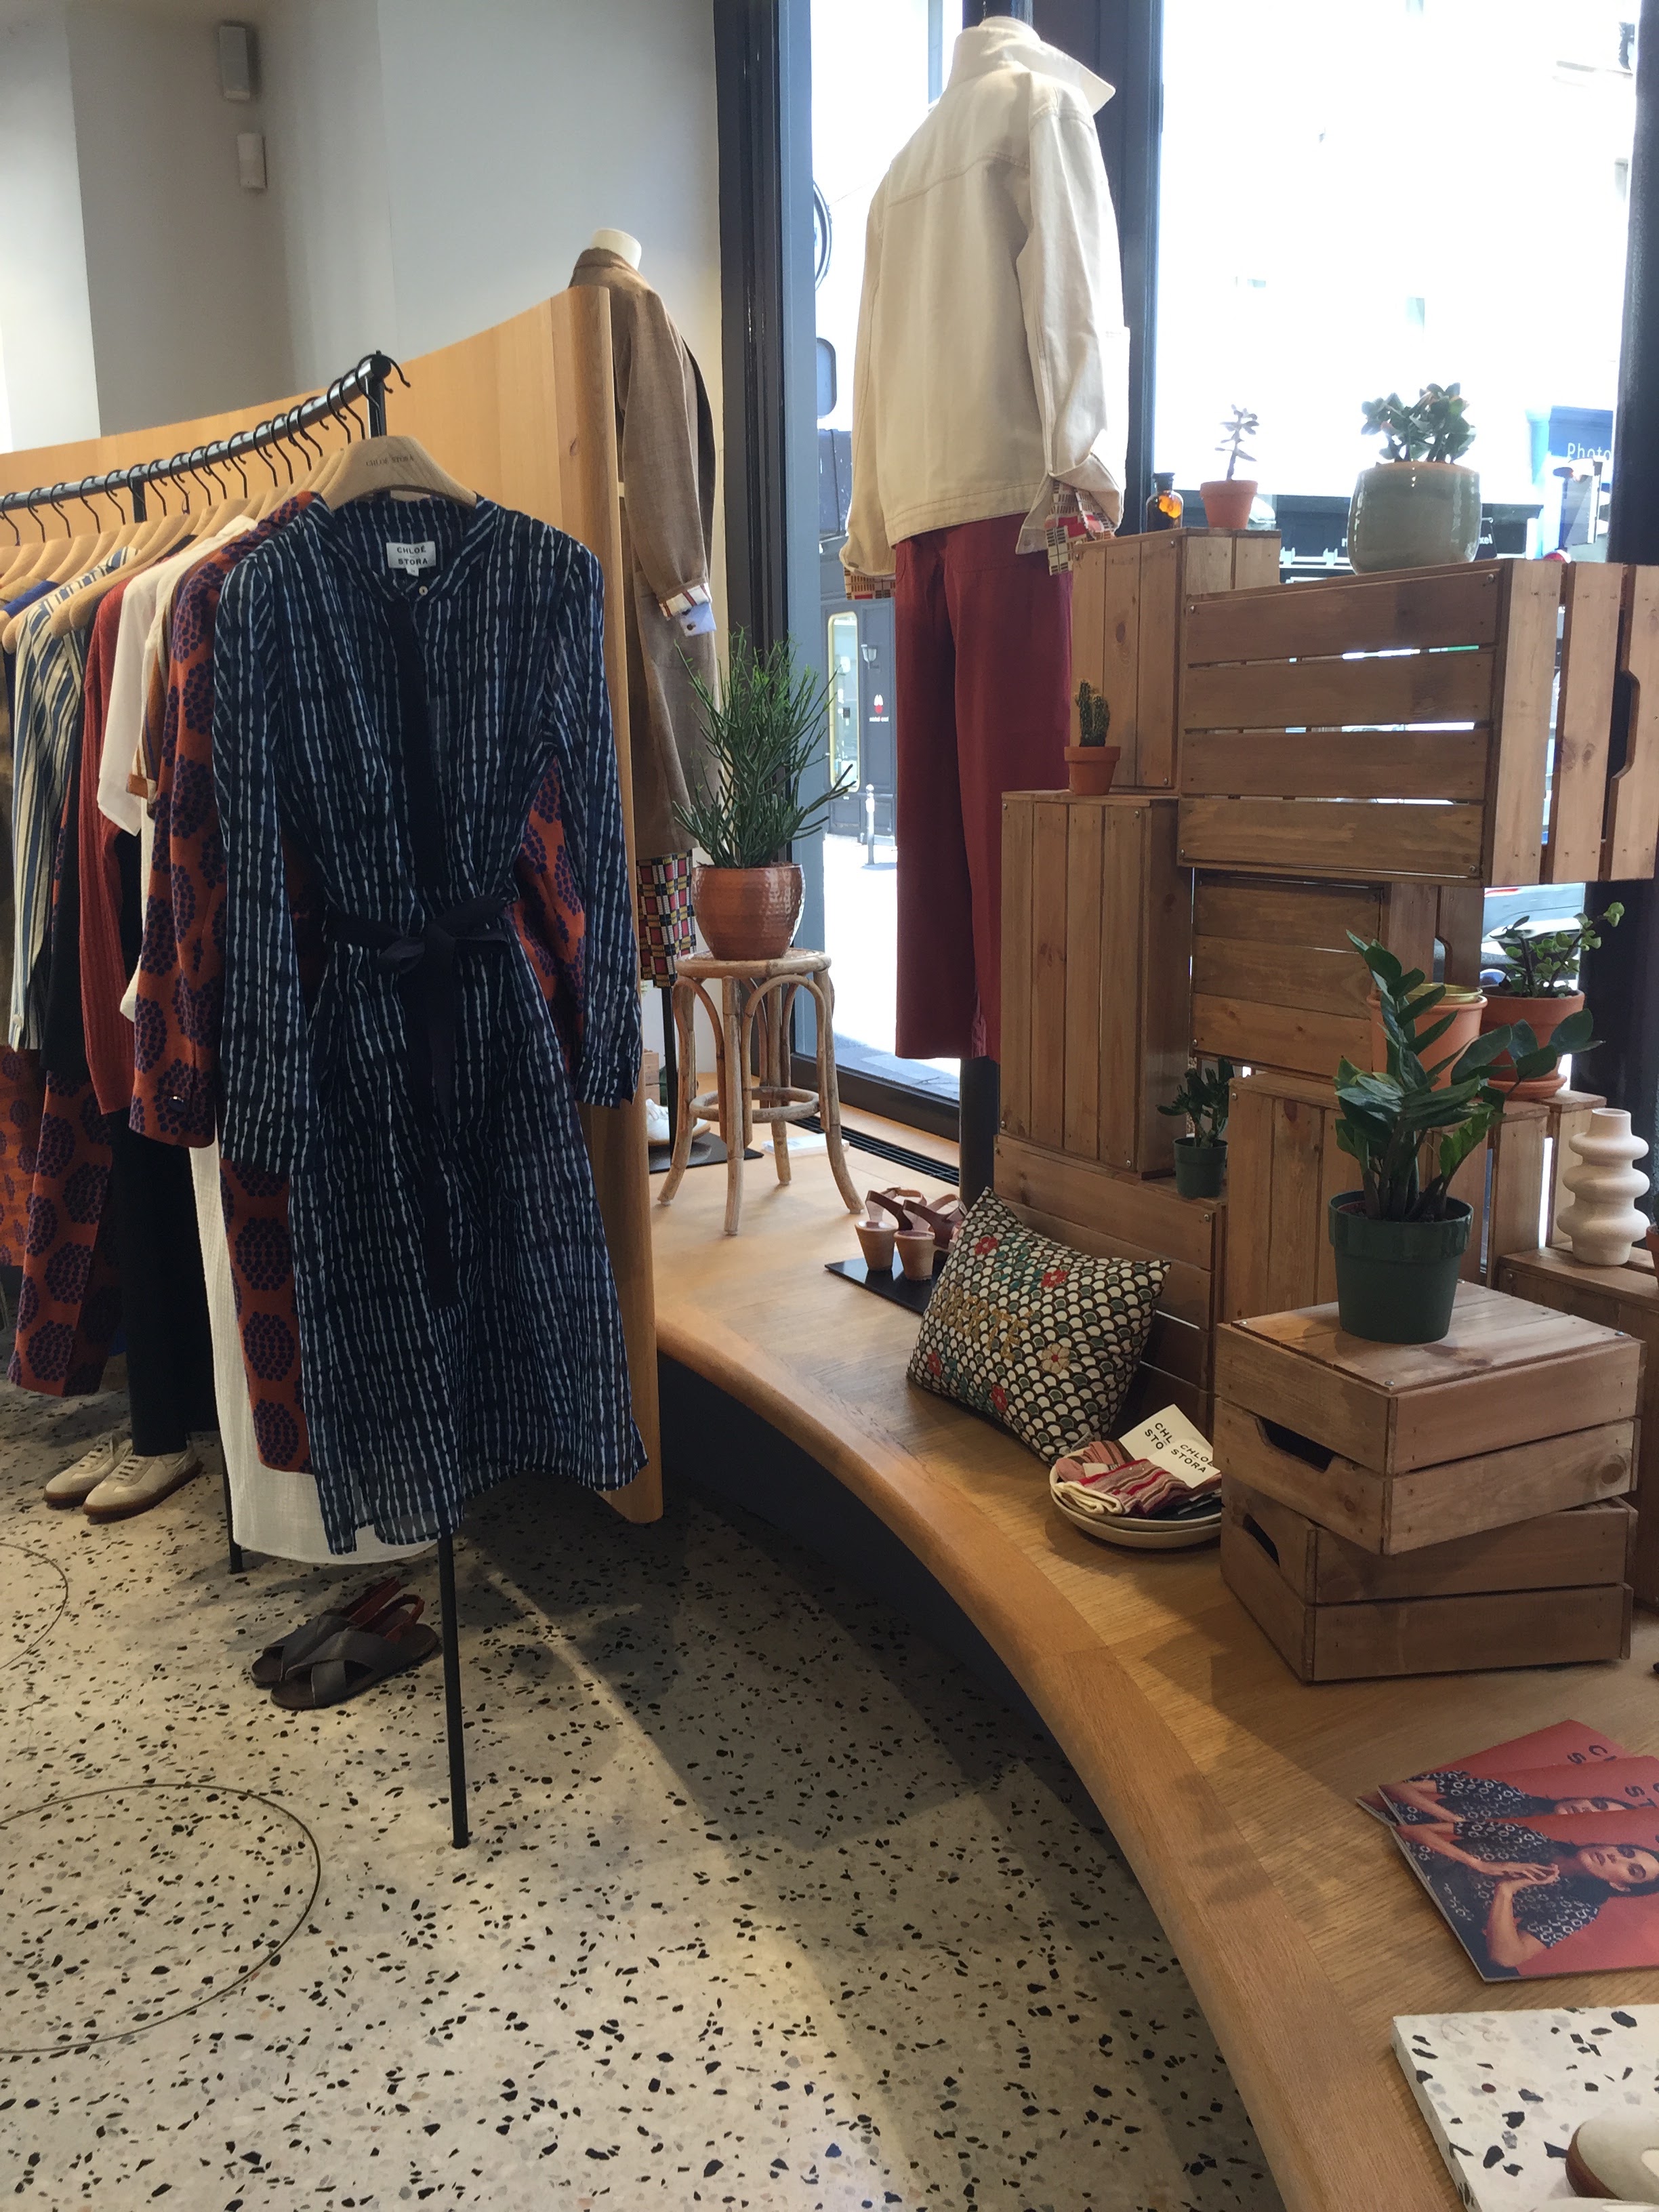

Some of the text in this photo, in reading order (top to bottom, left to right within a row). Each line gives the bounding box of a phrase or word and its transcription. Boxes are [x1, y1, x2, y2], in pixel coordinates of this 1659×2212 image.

[1567, 443, 1612, 461] Photo
[396, 545, 427, 554] CHLOÉ
[1144, 1428, 1164, 1450] STO
[1154, 1422, 1174, 1444] CHL
[1170, 1449, 1207, 1473] STORA
